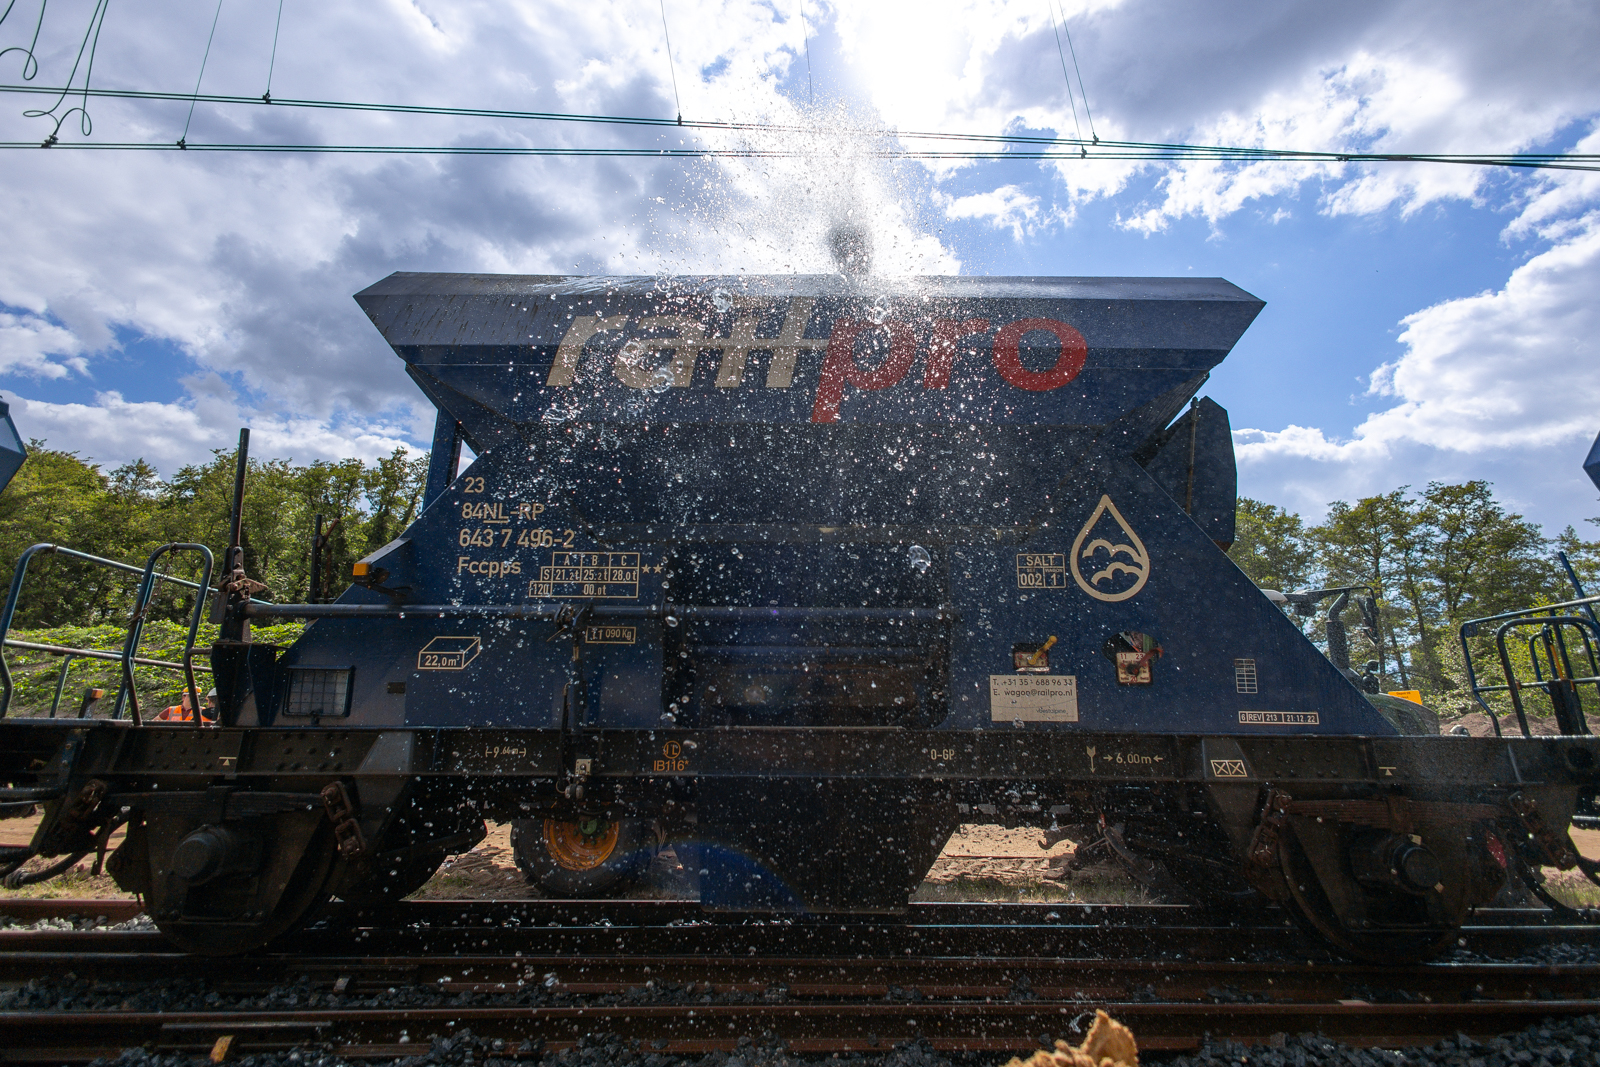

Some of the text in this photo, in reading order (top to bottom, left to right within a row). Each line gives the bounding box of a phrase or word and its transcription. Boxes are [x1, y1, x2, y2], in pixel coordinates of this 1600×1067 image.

[545, 290, 1088, 423] railpro
[464, 476, 485, 493] 23
[461, 502, 545, 521] 84NL-RP
[459, 528, 575, 548] 643 7 496-2
[563, 554, 627, 567] A B C
[1026, 555, 1055, 566] SALT
[457, 556, 521, 578] Fccpps
[543, 569, 550, 581] S
[1020, 573, 1057, 586] 002 1
[533, 583, 549, 595] 120
[605, 628, 621, 638] 090
[993, 678, 999, 686] T.
[1019, 678, 1029, 686] 35
[1035, 678, 1050, 686] 688
[1051, 678, 1062, 686] 96
[1063, 678, 1073, 686] 33
[993, 688, 1073, 698] E. wagon@railpro.nl
[1248, 713, 1262, 721] REV
[1265, 714, 1278, 722] 213
